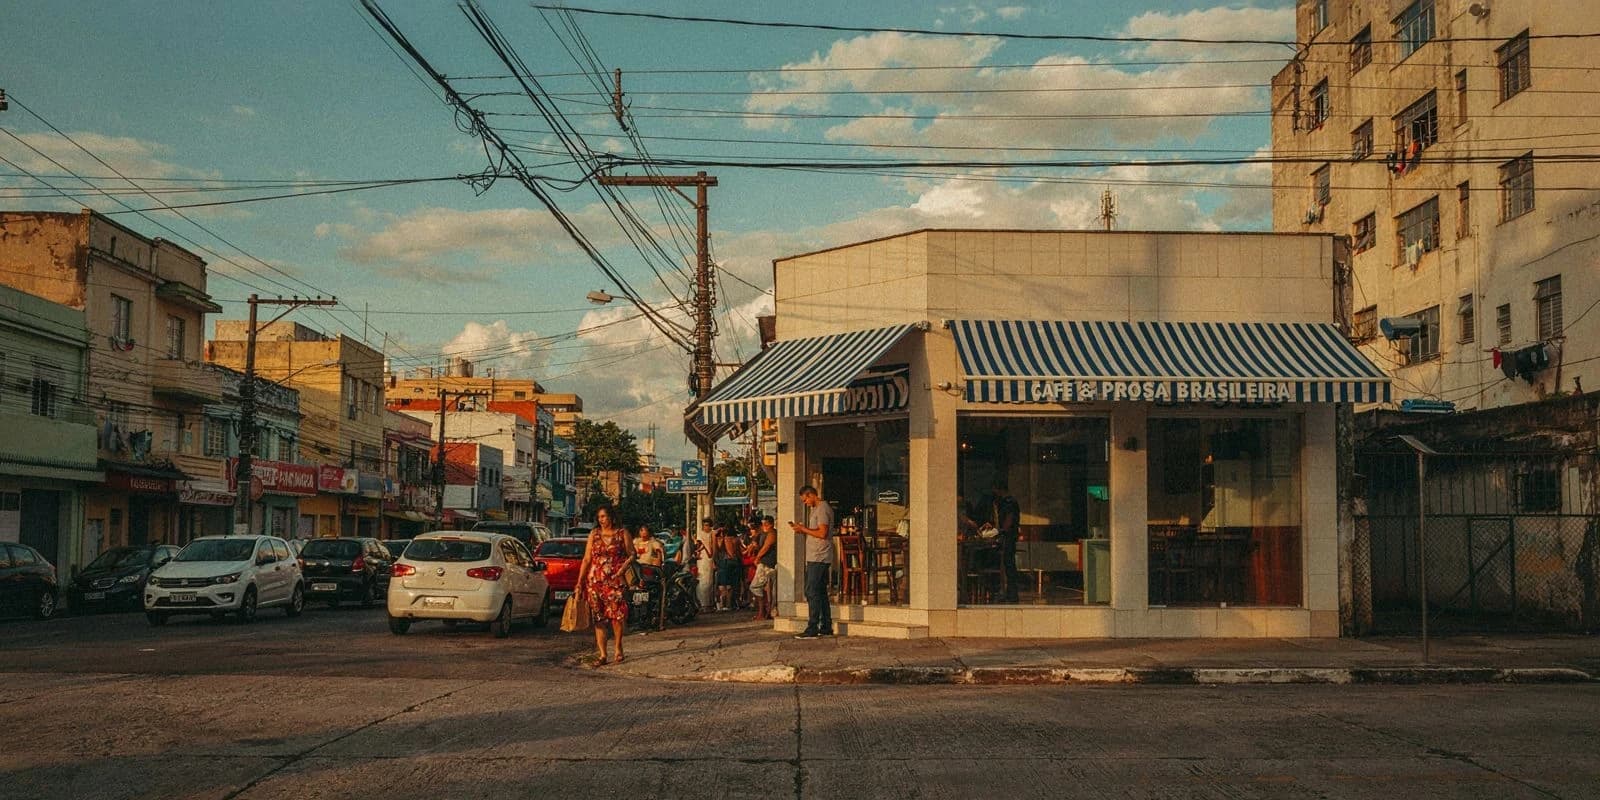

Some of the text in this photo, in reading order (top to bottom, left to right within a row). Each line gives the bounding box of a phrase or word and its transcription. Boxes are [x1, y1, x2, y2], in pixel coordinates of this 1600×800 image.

[1079, 382, 1096, 398] &
[1102, 382, 1169, 399] PROSA
[1177, 382, 1290, 399] BRASILEIRA
